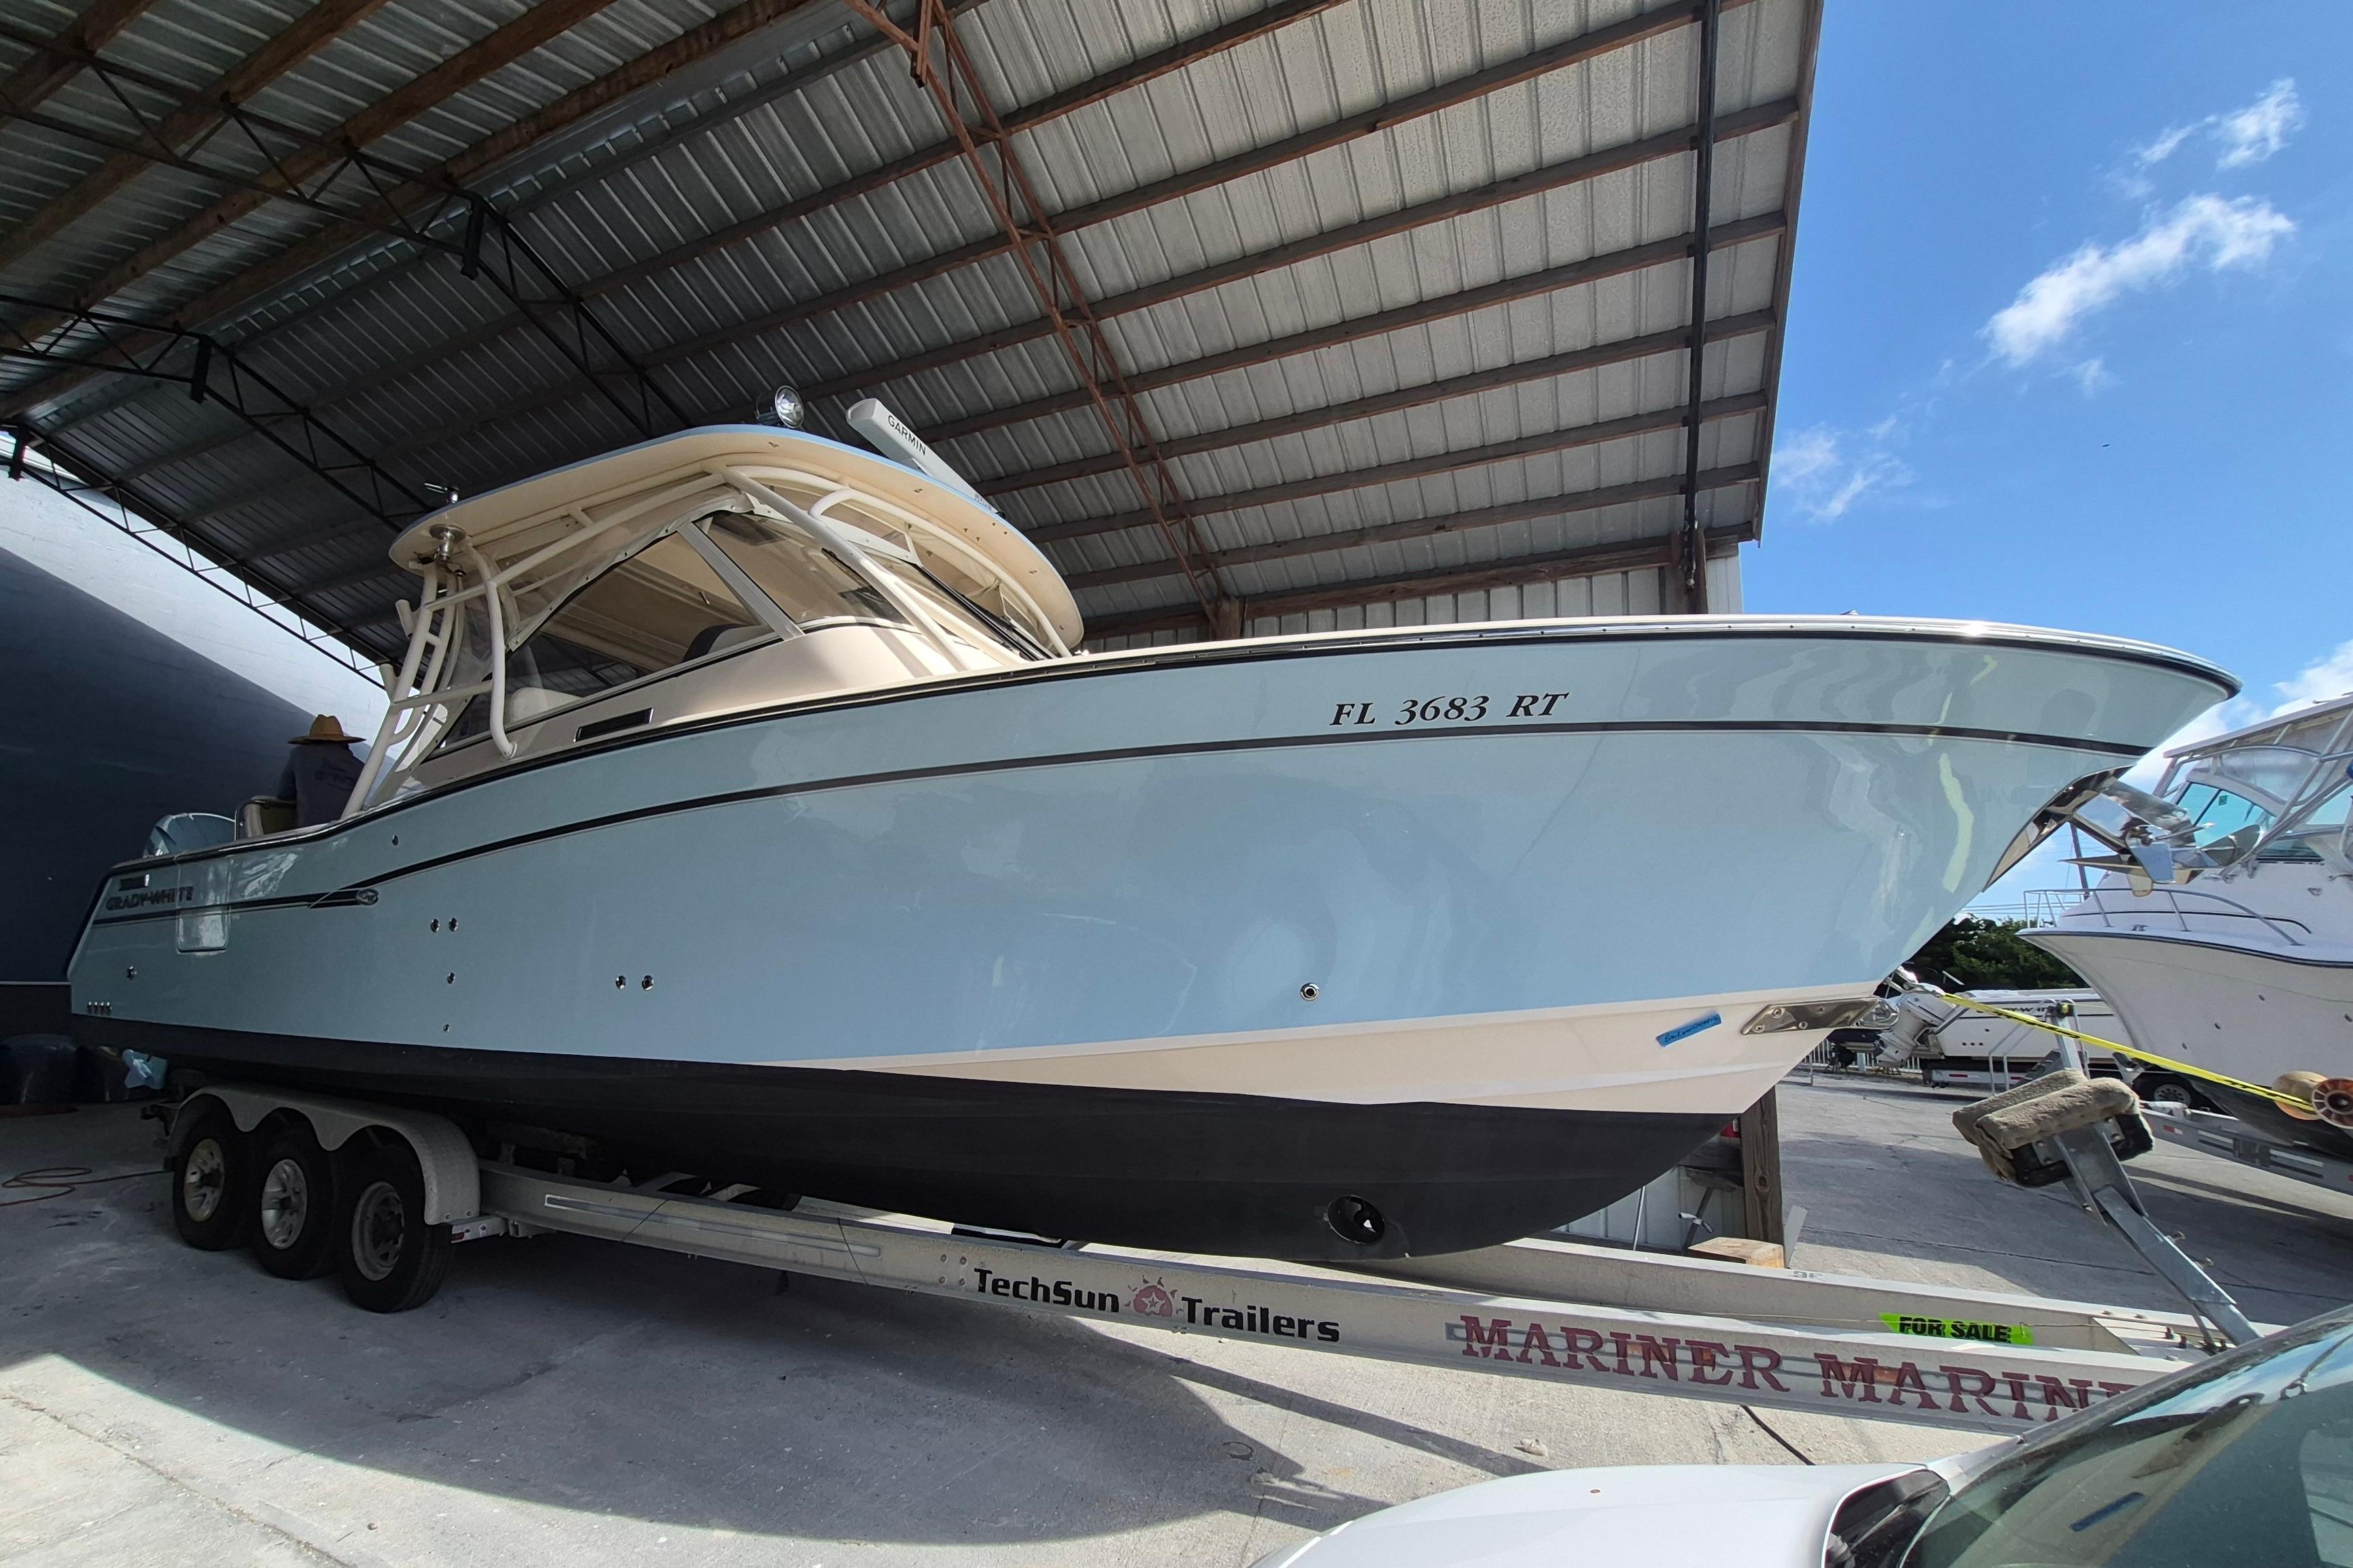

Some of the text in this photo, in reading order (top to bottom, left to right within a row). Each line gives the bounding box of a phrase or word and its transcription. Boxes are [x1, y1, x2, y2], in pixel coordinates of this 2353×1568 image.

[888, 414, 926, 456] GARMIN
[1329, 692, 1570, 725] FL 3683 RT
[974, 1268, 1340, 1342] TechSun Trailers
[1899, 1316, 2012, 1343] FOR SALE
[1460, 1315, 2138, 1422] MARINER MARIN
